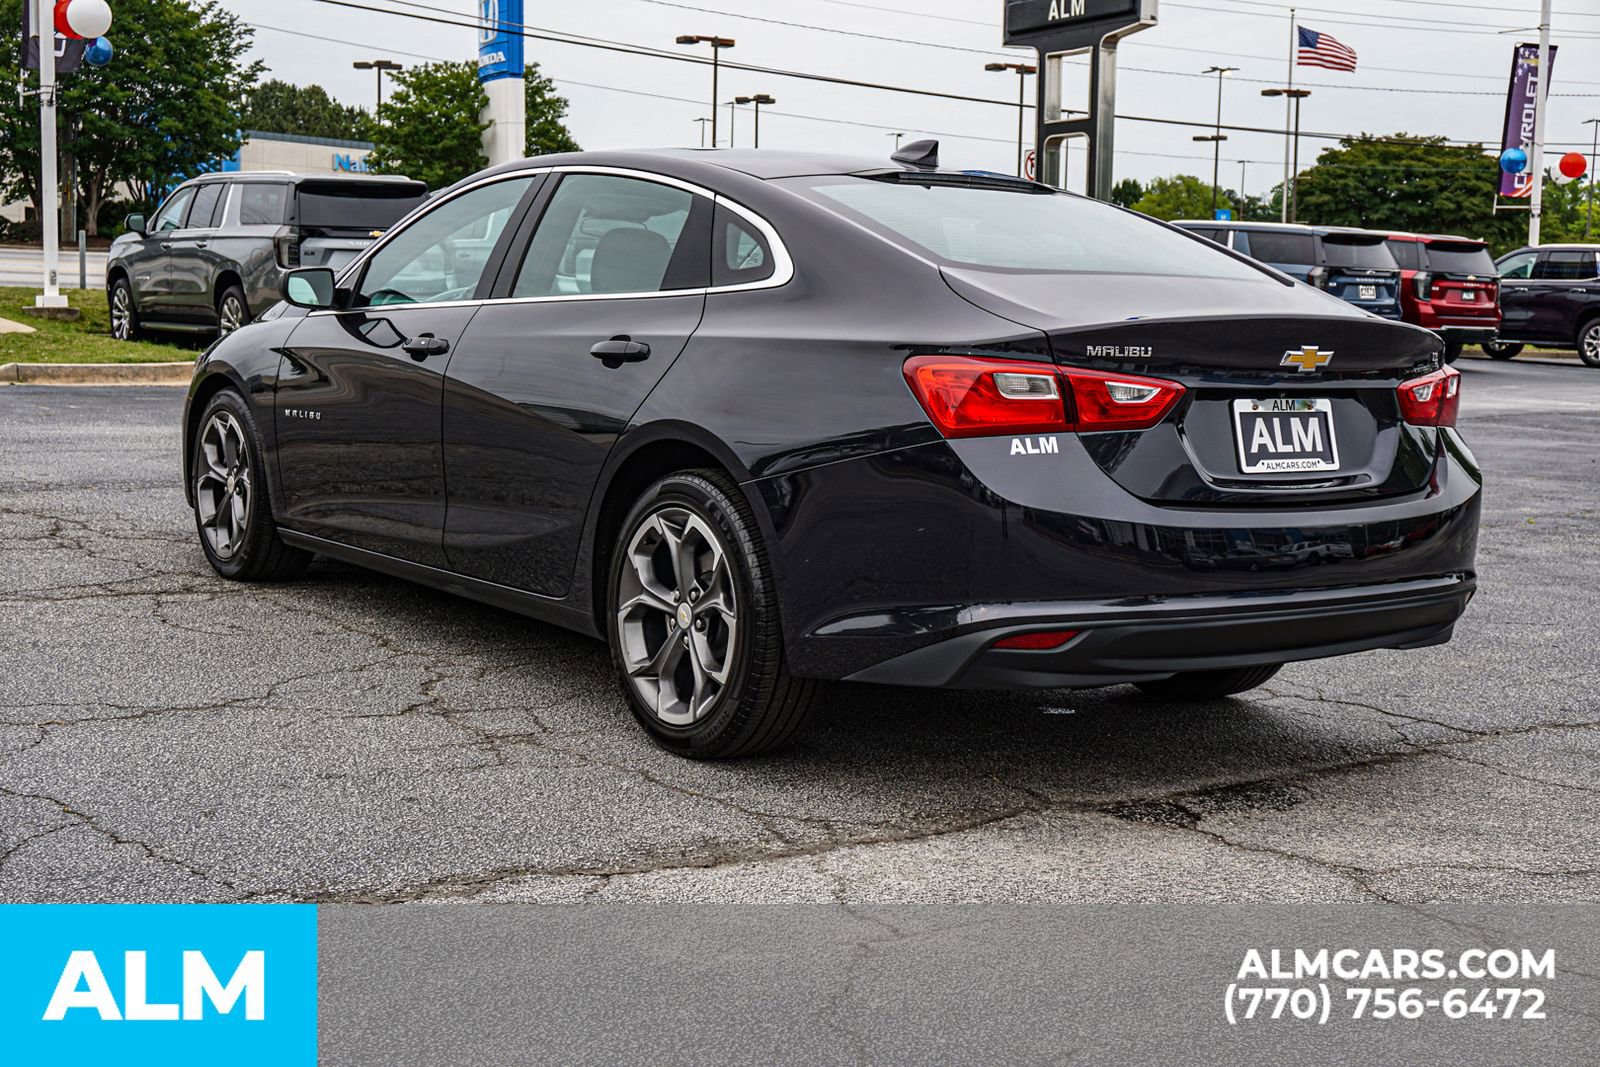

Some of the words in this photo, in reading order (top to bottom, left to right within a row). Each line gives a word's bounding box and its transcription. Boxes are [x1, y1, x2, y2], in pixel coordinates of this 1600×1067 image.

[1048, 0, 1085, 21] ALM
[1514, 72, 1538, 189] CROLET
[1086, 345, 1152, 357] MALIBU
[1272, 399, 1296, 411] ALM
[1250, 417, 1324, 453] ALM
[1010, 436, 1059, 455] ALM
[1266, 461, 1318, 470] ALMCARS.COM
